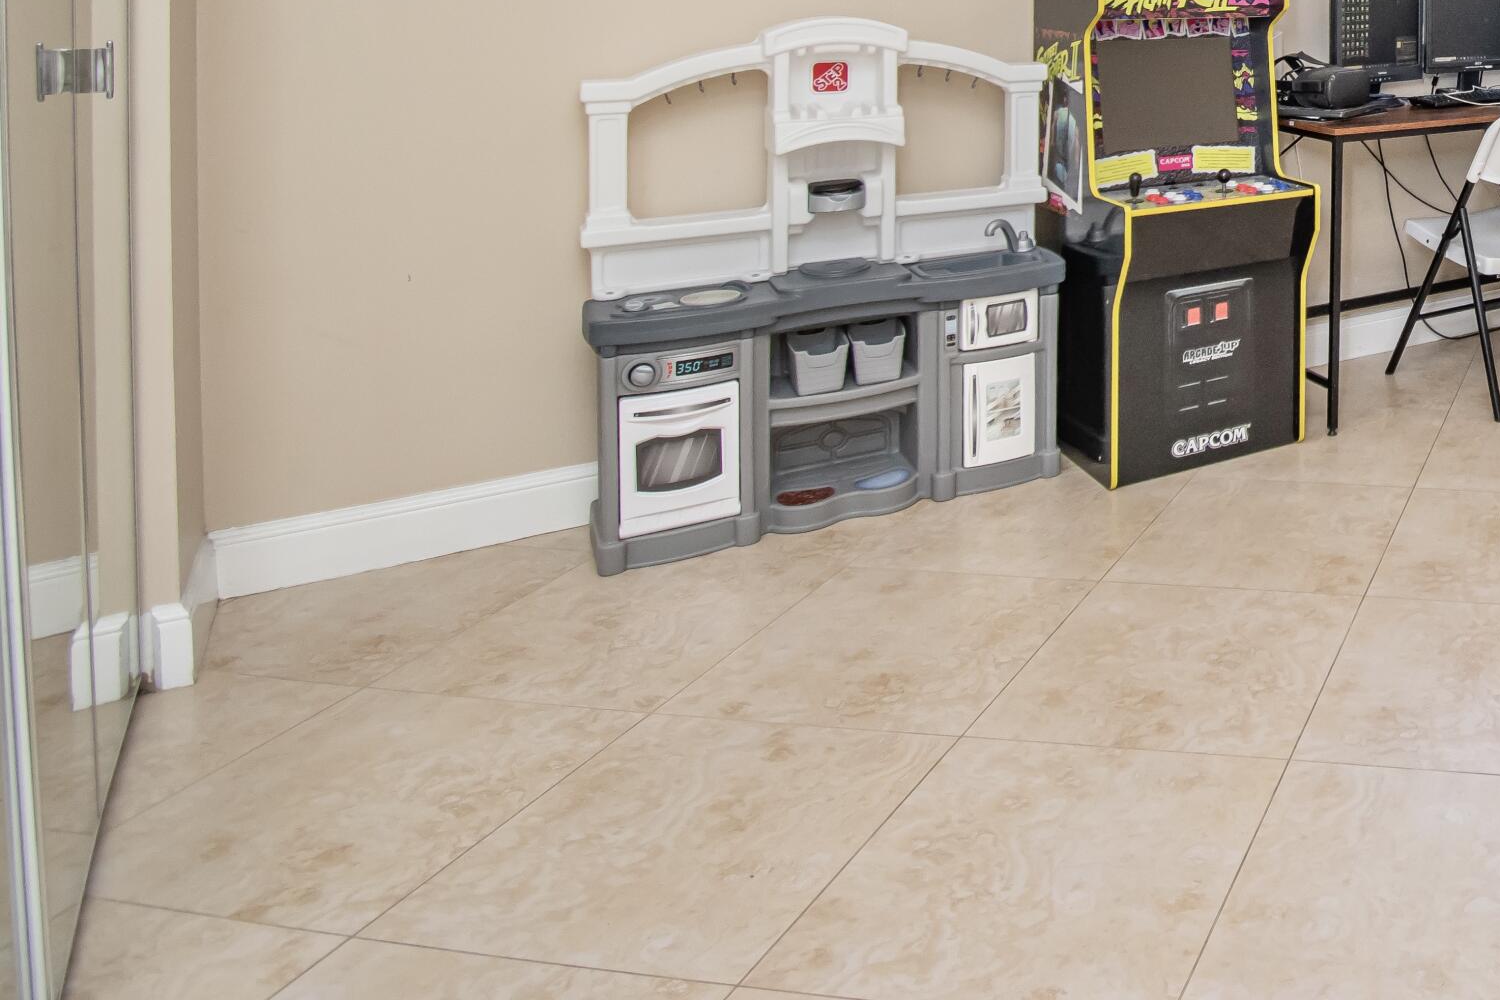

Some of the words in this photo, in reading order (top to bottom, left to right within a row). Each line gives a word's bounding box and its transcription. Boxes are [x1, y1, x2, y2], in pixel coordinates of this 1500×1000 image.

[814, 63, 844, 91] STEP
[832, 77, 847, 91] 2
[1159, 156, 1190, 165] CAPCOM
[1172, 424, 1250, 458] CAPCOM
